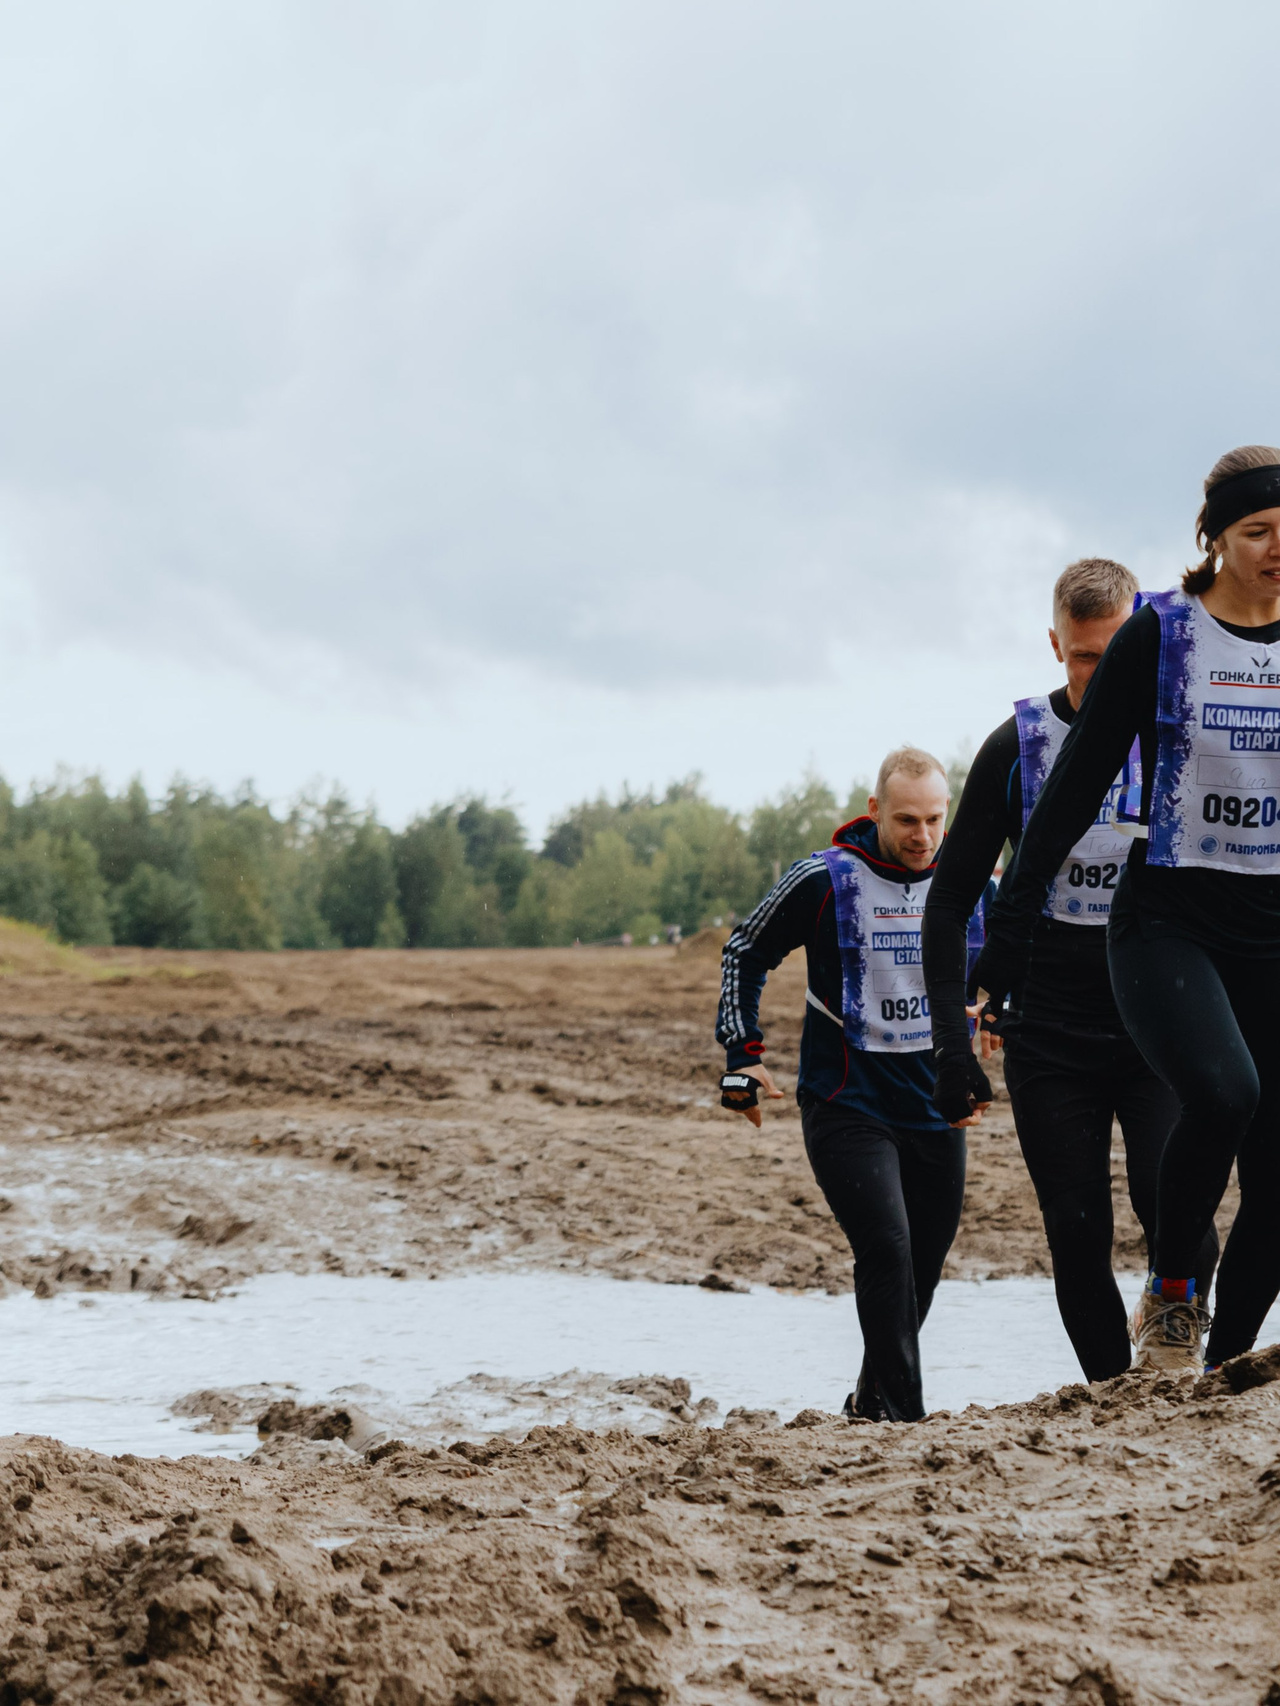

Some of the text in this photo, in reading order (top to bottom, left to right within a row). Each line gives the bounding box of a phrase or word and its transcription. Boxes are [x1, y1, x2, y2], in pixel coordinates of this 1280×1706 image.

[1210, 670, 1255, 684] ГОНКА
[1068, 862, 1127, 889] 092
[873, 906, 908, 915] ГОНКА
[896, 950, 923, 964] СТА
[881, 994, 931, 1022] 0920
[900, 1030, 932, 1041] ГАЗПРОМ
